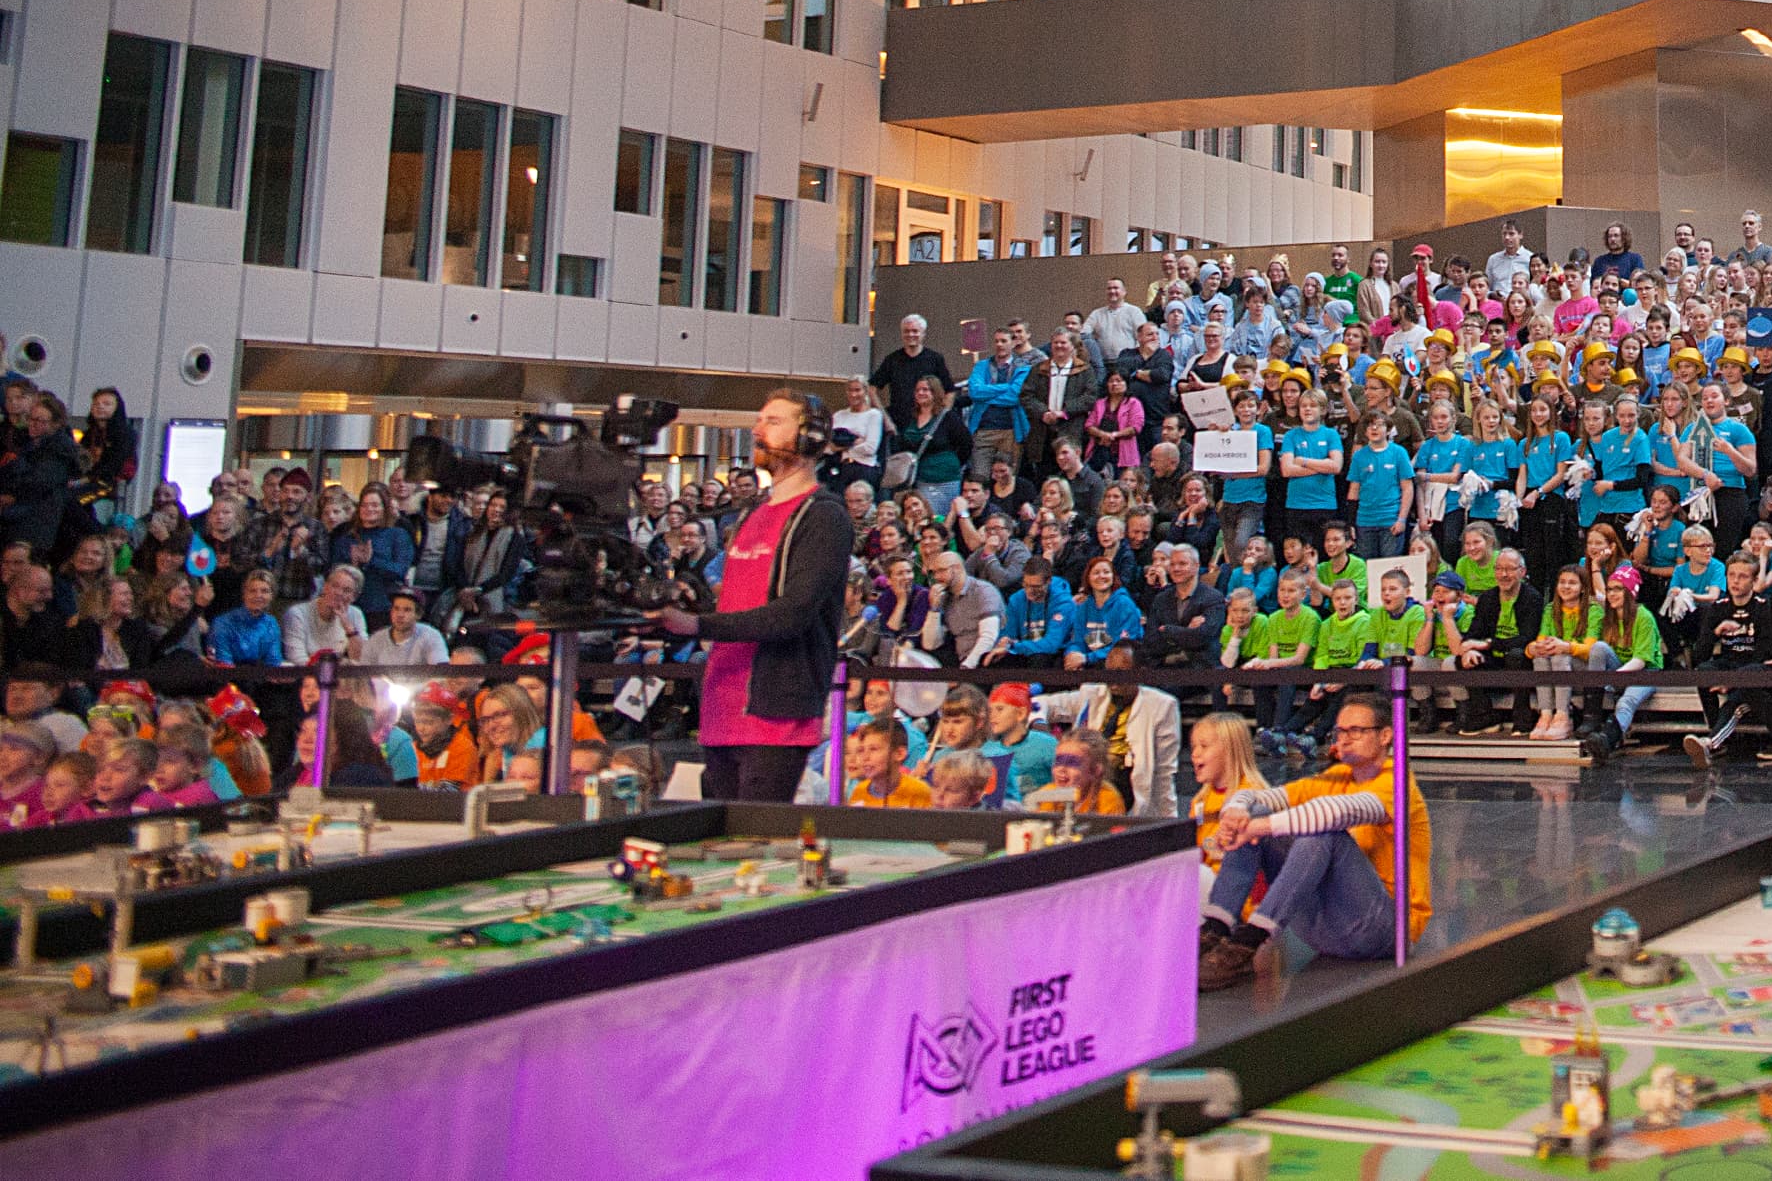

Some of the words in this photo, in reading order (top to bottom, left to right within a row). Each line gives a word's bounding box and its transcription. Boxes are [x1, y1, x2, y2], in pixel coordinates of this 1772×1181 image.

[914, 239, 935, 260] A2
[1009, 972, 1072, 1018] FIRST
[1004, 1011, 1065, 1053] LEGO
[1001, 1034, 1096, 1087] LEAGUE
